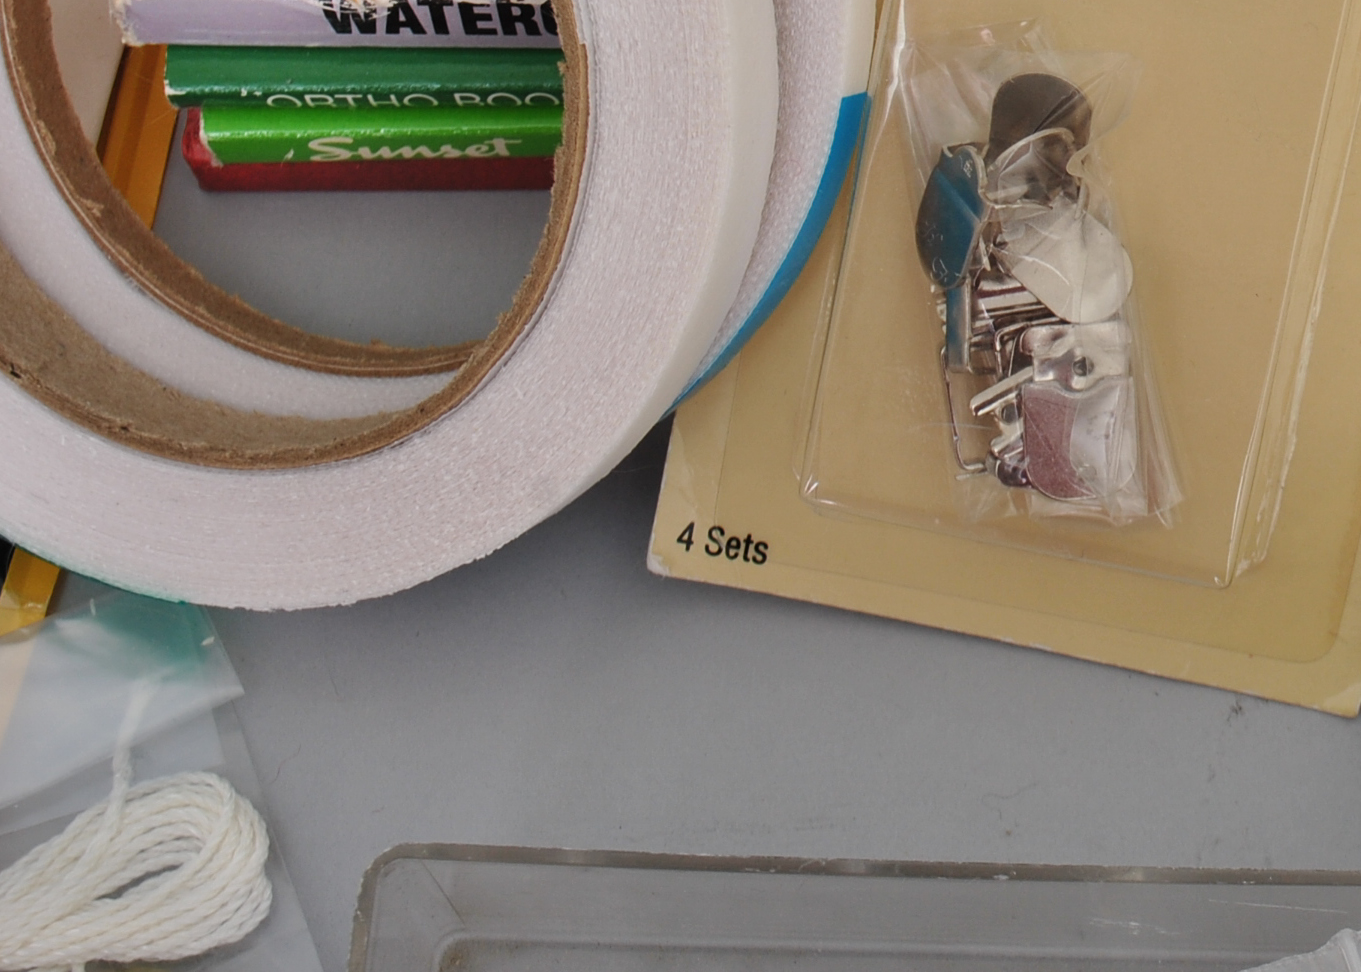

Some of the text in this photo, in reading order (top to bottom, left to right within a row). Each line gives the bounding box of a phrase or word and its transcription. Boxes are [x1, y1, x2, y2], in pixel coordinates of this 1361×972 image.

[308, 137, 522, 162] Sunset
[676, 522, 770, 566] 4 Sets
